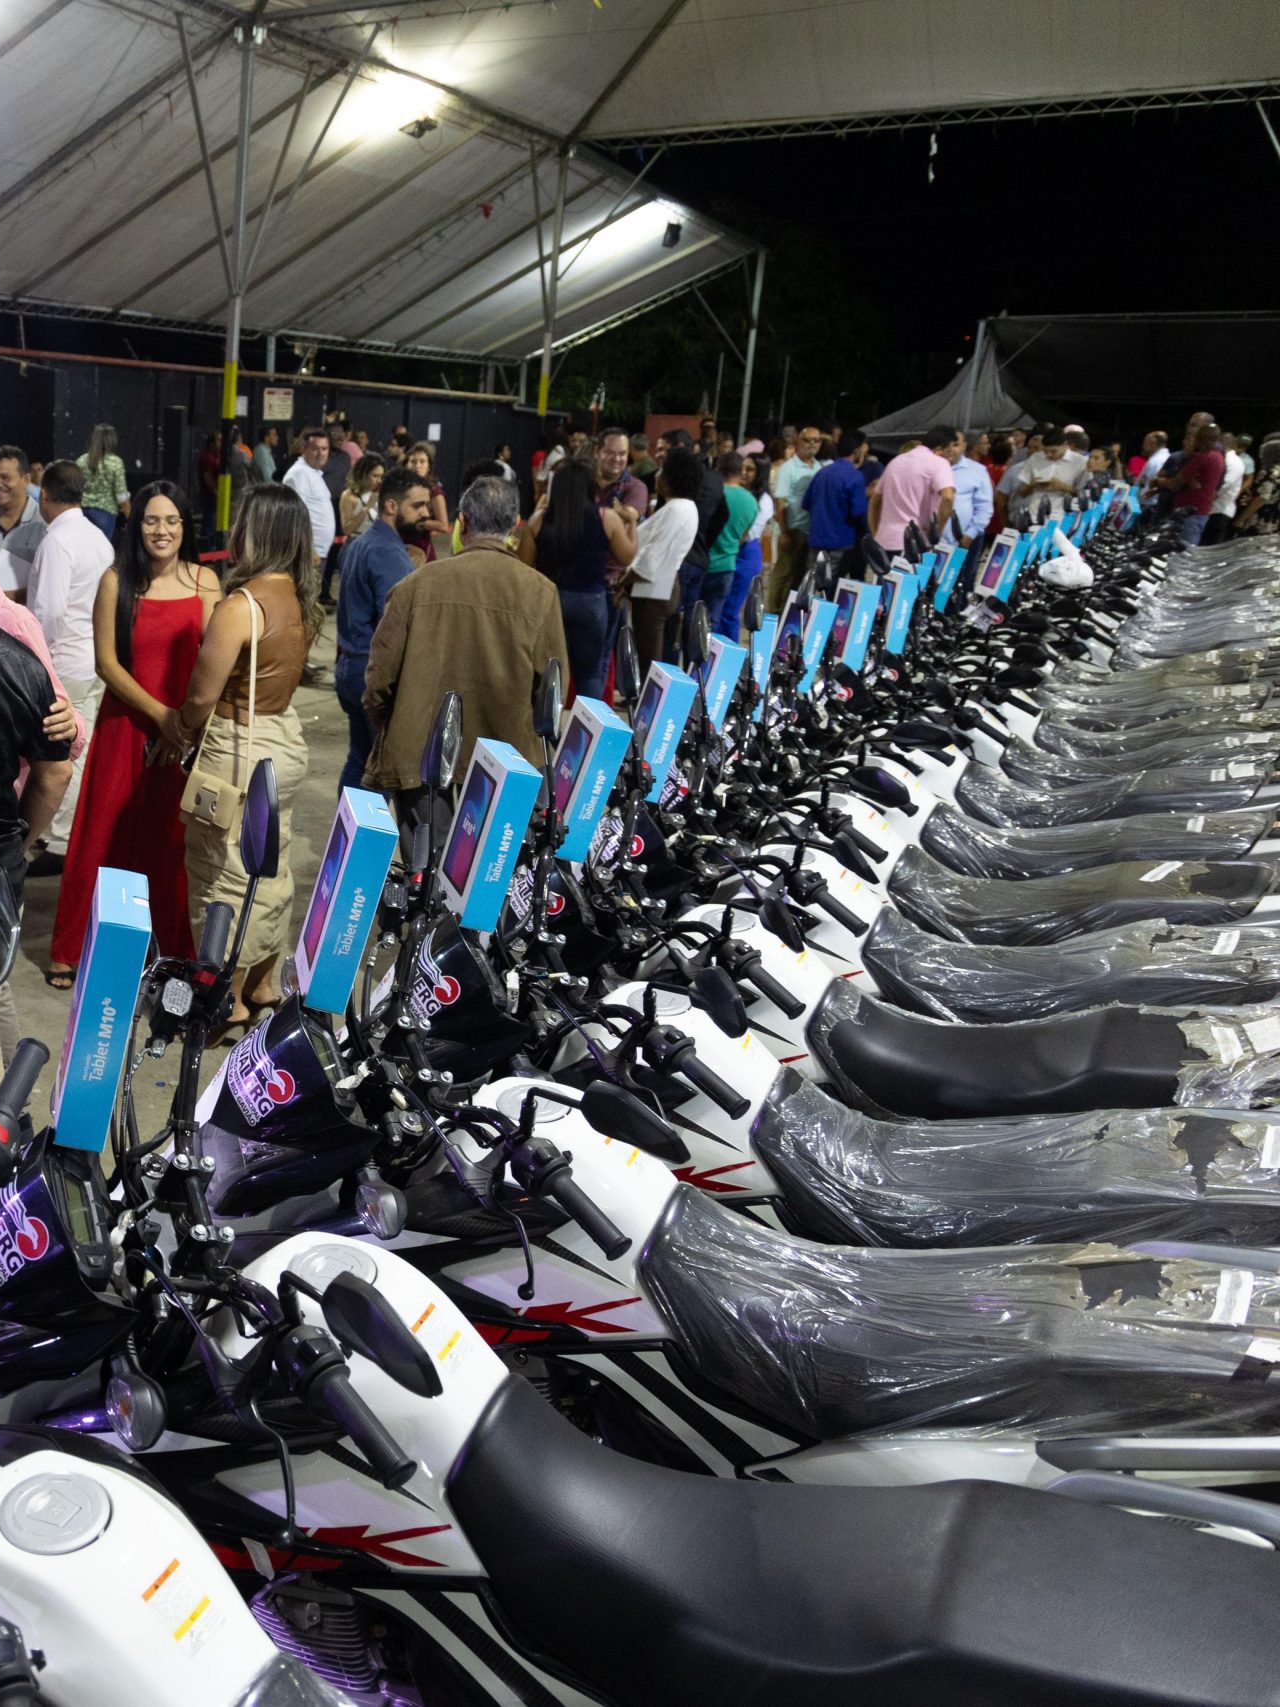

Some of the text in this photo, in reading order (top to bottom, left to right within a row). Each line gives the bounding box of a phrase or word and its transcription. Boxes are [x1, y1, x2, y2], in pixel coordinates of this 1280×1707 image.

[489, 851, 506, 882] Tablet
[338, 923, 357, 955] Tablet
[88, 1041, 109, 1082] Tablet
